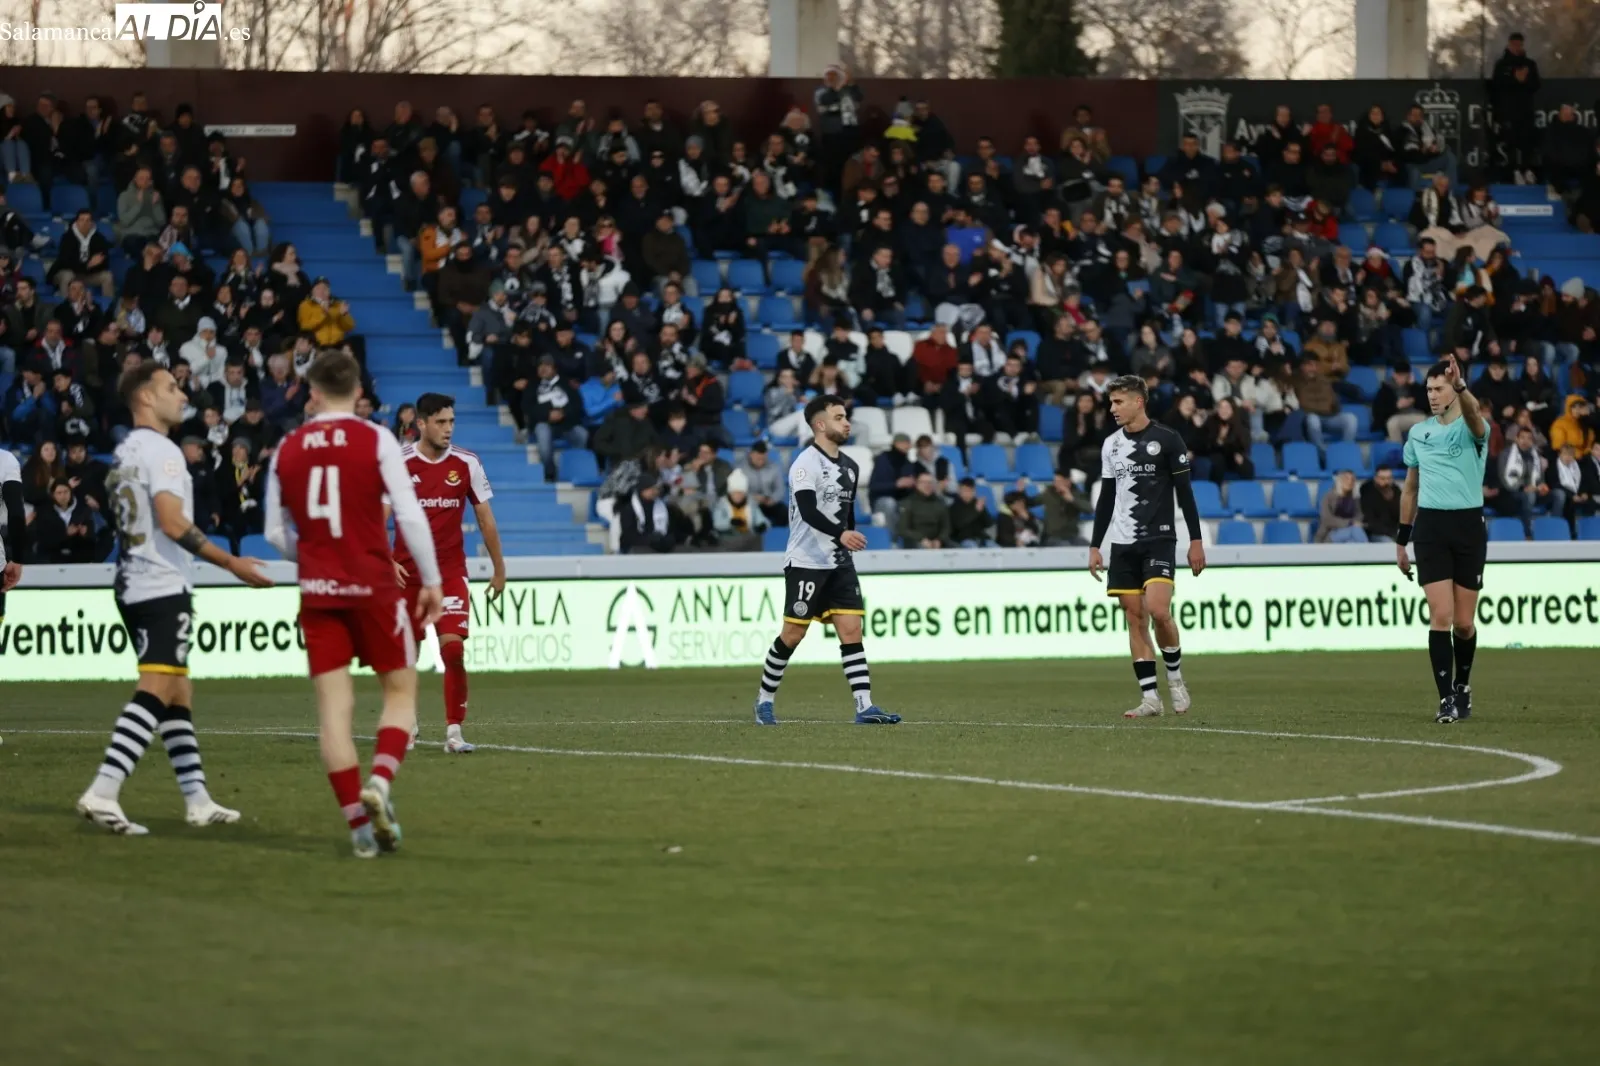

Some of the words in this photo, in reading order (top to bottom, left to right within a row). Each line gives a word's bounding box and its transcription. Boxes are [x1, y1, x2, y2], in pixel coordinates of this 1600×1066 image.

[1128, 464, 1142, 472] Don
[1144, 464, 1156, 473] QR
[307, 465, 343, 538] 4
[670, 585, 777, 623] ANYLA
[798, 580, 816, 601] 19
[823, 597, 940, 638] Leres
[954, 606, 991, 635] en
[1004, 594, 1252, 634] mantenento
[1266, 584, 1431, 641] preventivo
[1478, 587, 1599, 625] correct
[190, 620, 306, 653] orrect
